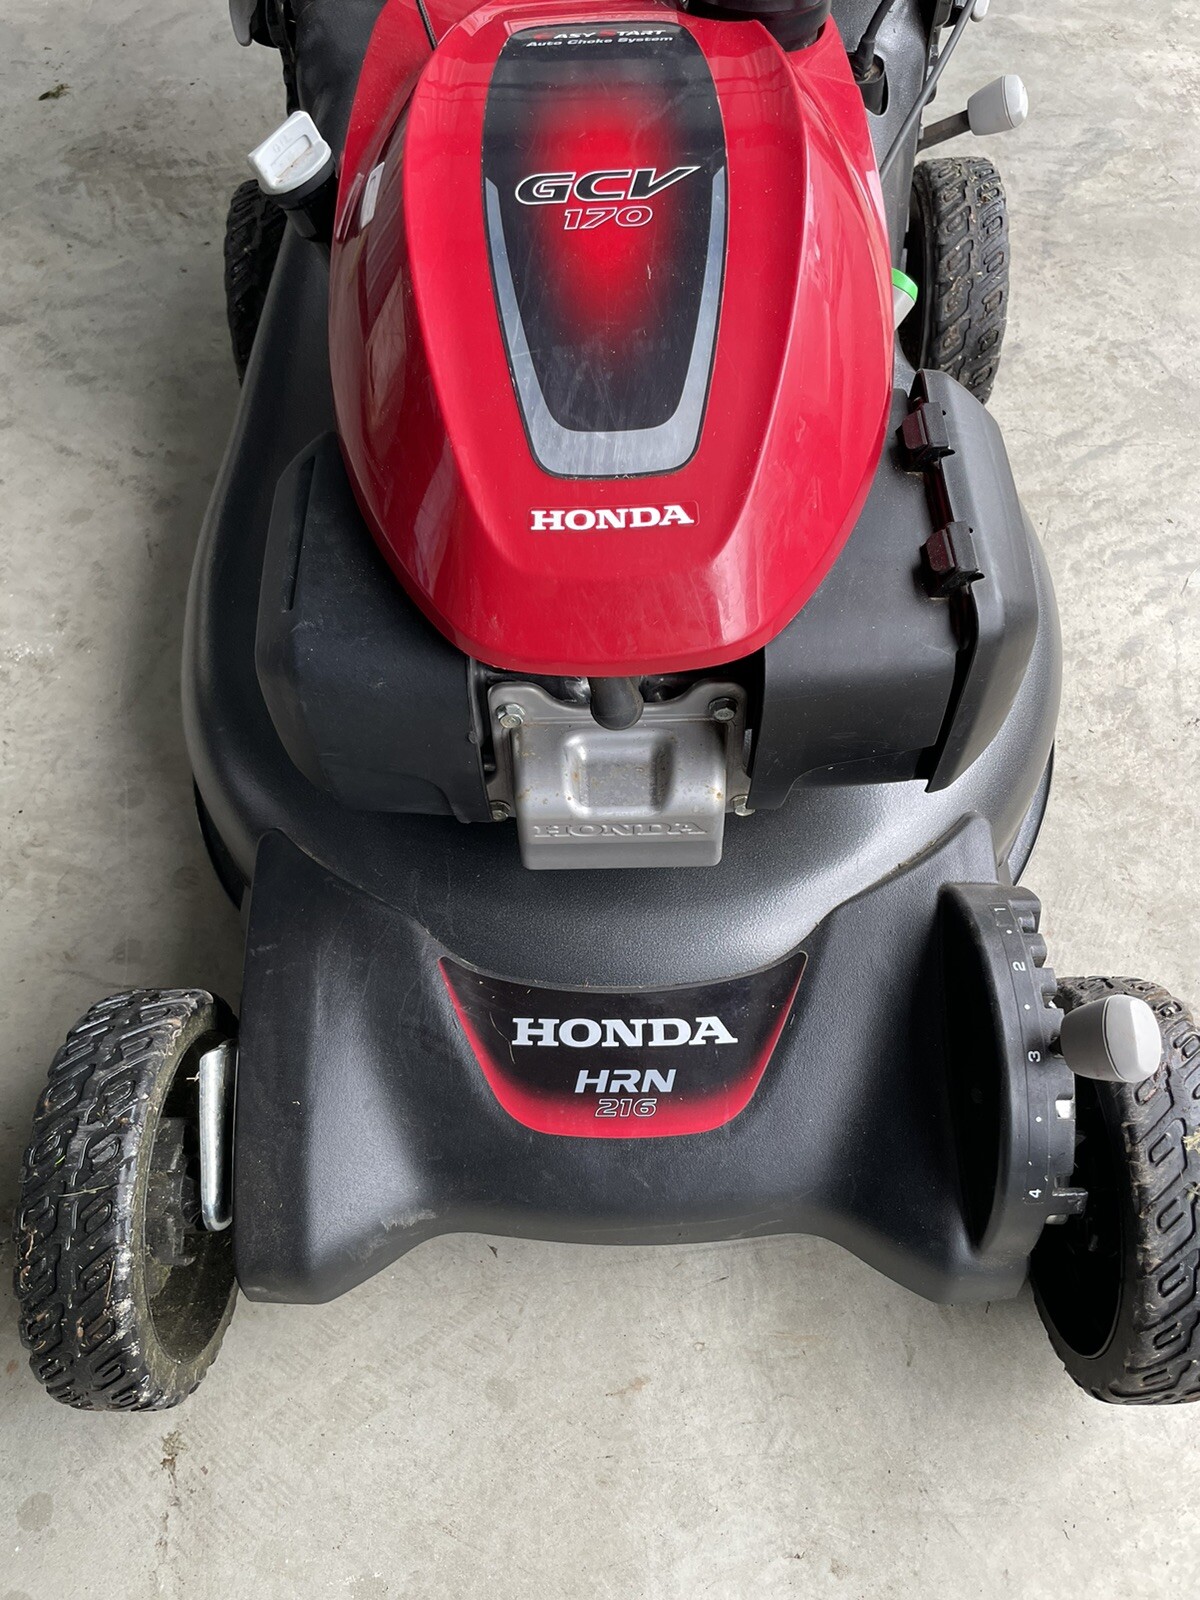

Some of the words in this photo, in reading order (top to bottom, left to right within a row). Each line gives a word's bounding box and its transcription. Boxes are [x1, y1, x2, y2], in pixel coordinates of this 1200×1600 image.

[567, 37, 613, 45] Choke
[617, 36, 673, 44] System
[515, 165, 701, 205] GCV
[563, 205, 653, 230] 170
[530, 504, 694, 531] HONDA
[533, 820, 707, 838] HONDA
[1012, 961, 1026, 971] 2
[511, 1015, 738, 1048] HONDA
[1028, 1050, 1041, 1062] 3
[574, 1069, 676, 1094] HRN
[594, 1097, 657, 1117] 216
[1028, 1188, 1042, 1198] 4
